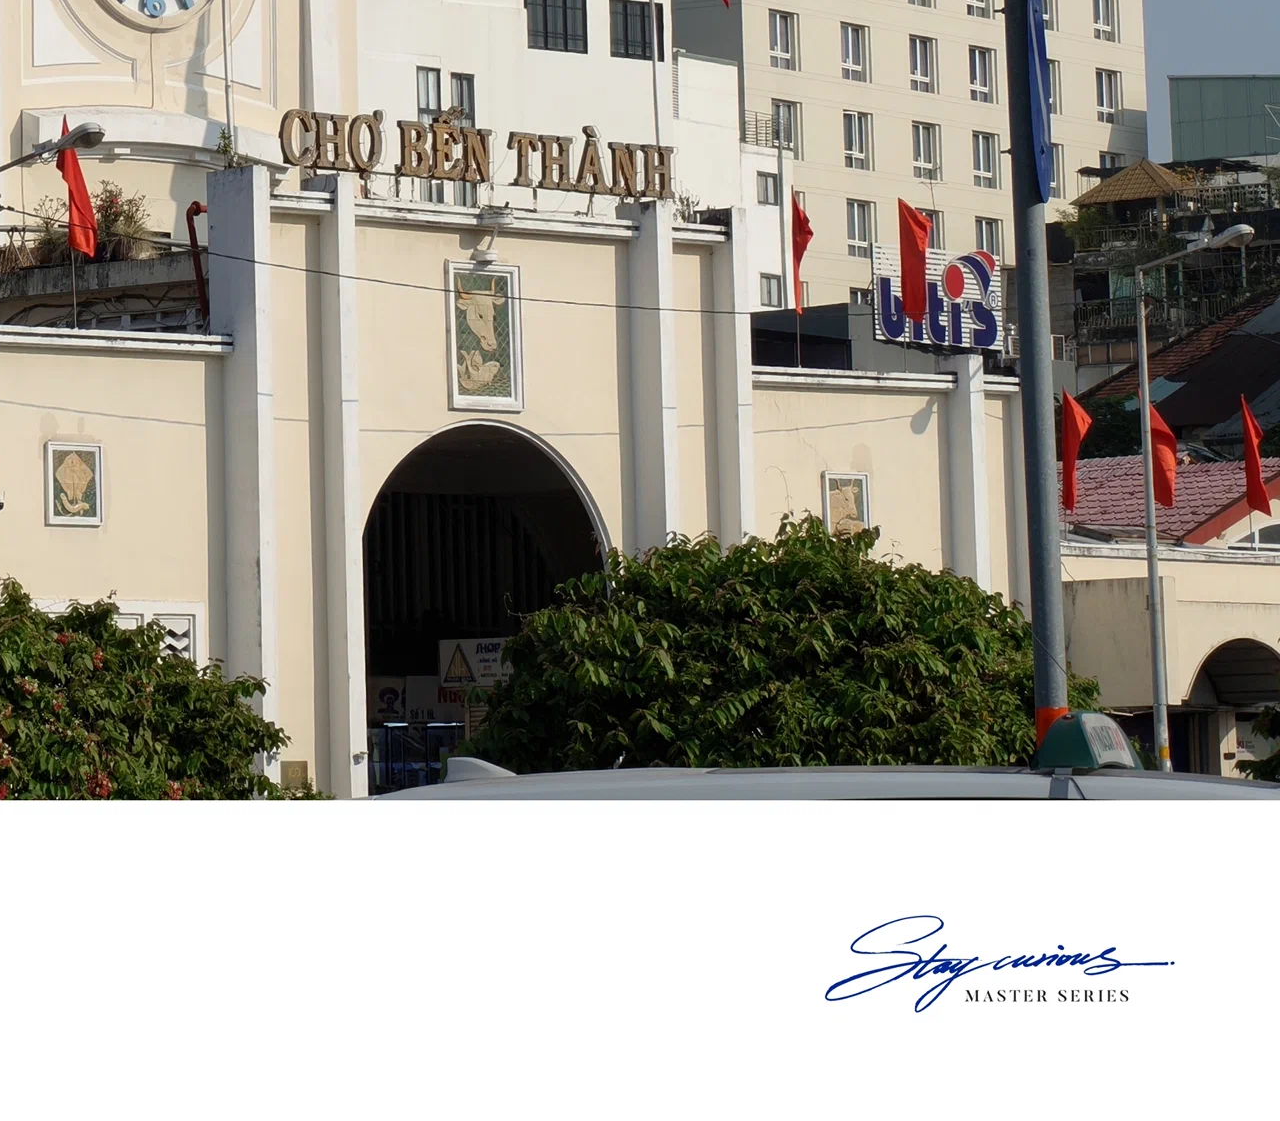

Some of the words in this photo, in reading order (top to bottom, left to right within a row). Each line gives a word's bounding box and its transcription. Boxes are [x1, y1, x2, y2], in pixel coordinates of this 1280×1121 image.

[279, 108, 384, 179] CHỢ
[397, 106, 492, 182] BẾN
[508, 125, 675, 199] THÀNH
